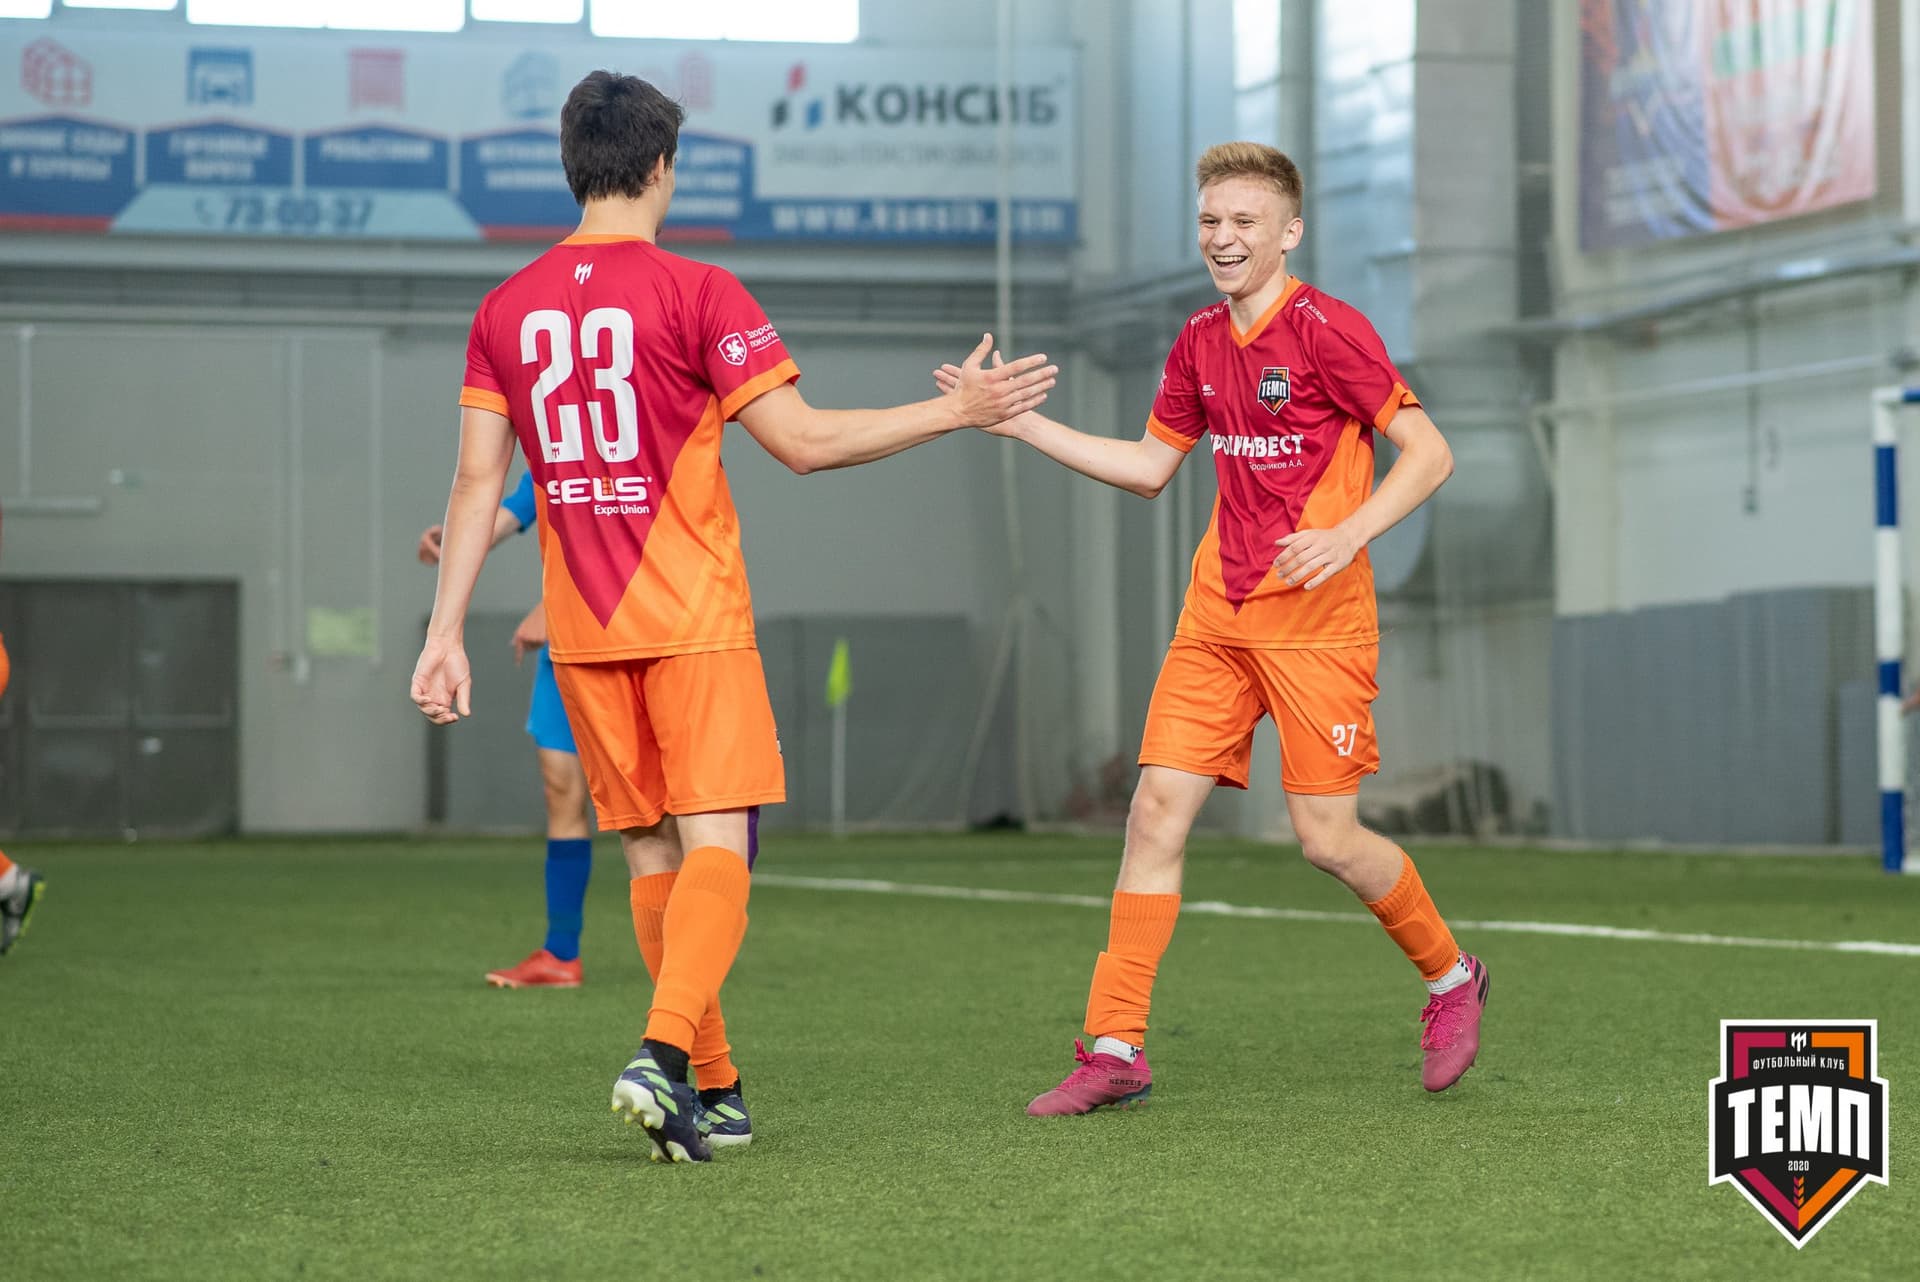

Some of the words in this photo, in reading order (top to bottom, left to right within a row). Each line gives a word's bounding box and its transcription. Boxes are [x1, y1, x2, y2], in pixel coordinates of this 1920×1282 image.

[836, 84, 1058, 125] КОНСИБ
[520, 307, 639, 463] 23
[1261, 380, 1288, 398] ТЕМП
[594, 504, 619, 516] Expo
[620, 504, 650, 515] Union
[1332, 723, 1358, 757] 27
